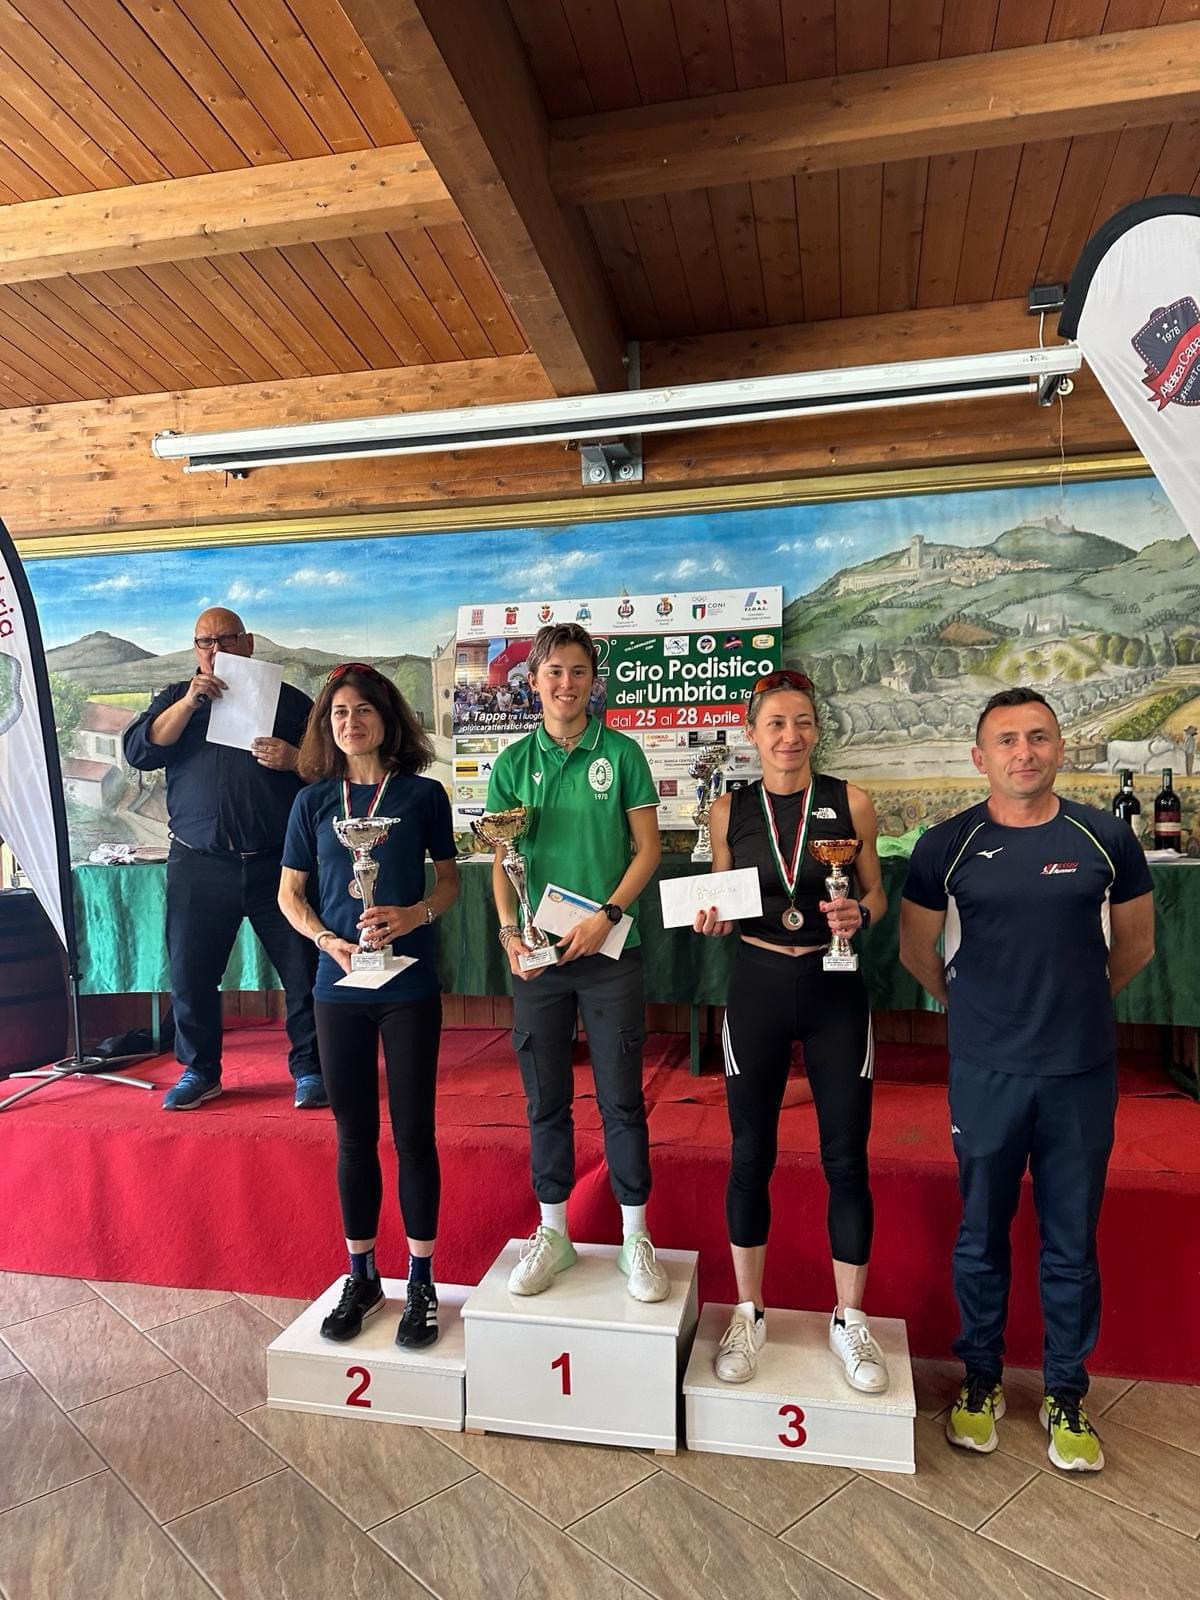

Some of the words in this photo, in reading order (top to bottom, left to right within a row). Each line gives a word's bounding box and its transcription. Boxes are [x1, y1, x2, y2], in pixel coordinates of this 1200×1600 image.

[1162, 326, 1181, 343] 1978
[615, 660, 664, 683] Giro
[669, 656, 774, 681] Podistico
[615, 680, 727, 705] dell'Umbria
[729, 690, 738, 700] a
[740, 688, 752, 700] Ta
[462, 711, 470, 722] 4
[473, 711, 507, 723] Tappe
[523, 721, 540, 730] dell'
[611, 714, 632, 728] dal
[635, 709, 657, 727] 25
[660, 713, 673, 726] al
[676, 707, 698, 726] 28
[702, 710, 741, 726] Aprile
[345, 1366, 372, 1407] 2
[551, 1352, 571, 1396] 1
[777, 1404, 807, 1448] 3
